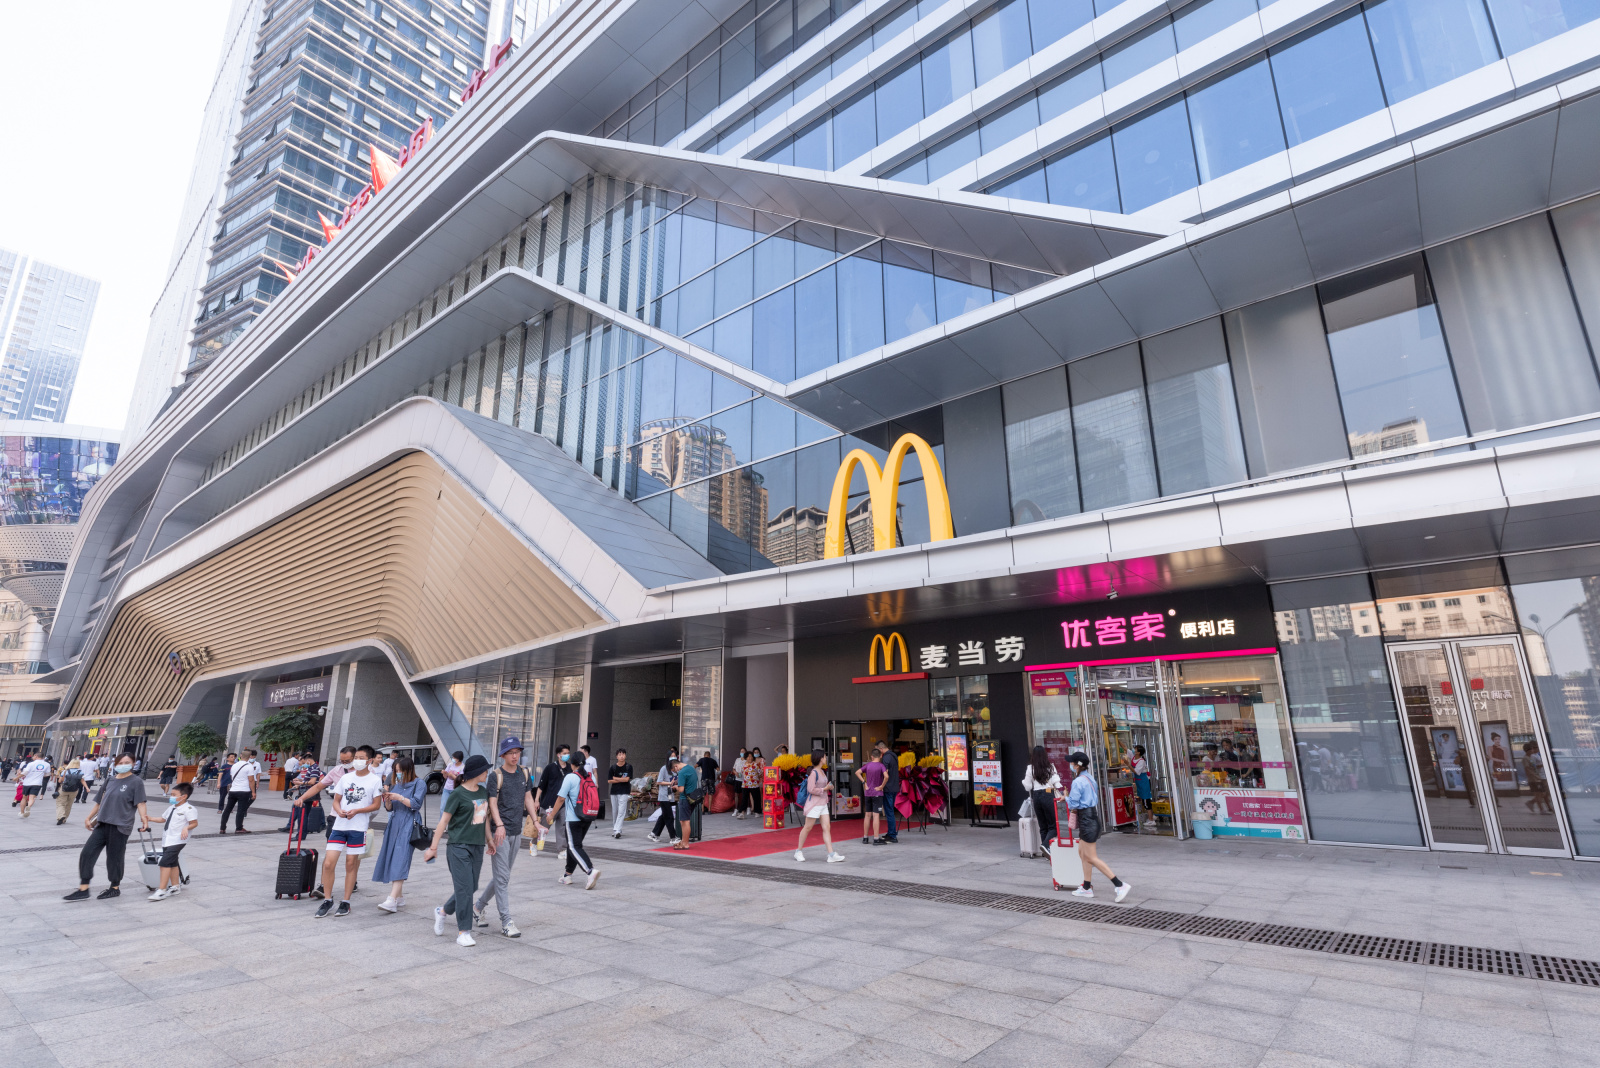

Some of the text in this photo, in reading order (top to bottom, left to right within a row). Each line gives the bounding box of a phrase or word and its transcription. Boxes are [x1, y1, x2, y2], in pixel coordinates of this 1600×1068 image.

[1060, 611, 1236, 649] 优客家 便利店
[919, 635, 1026, 670] 麦当劳
